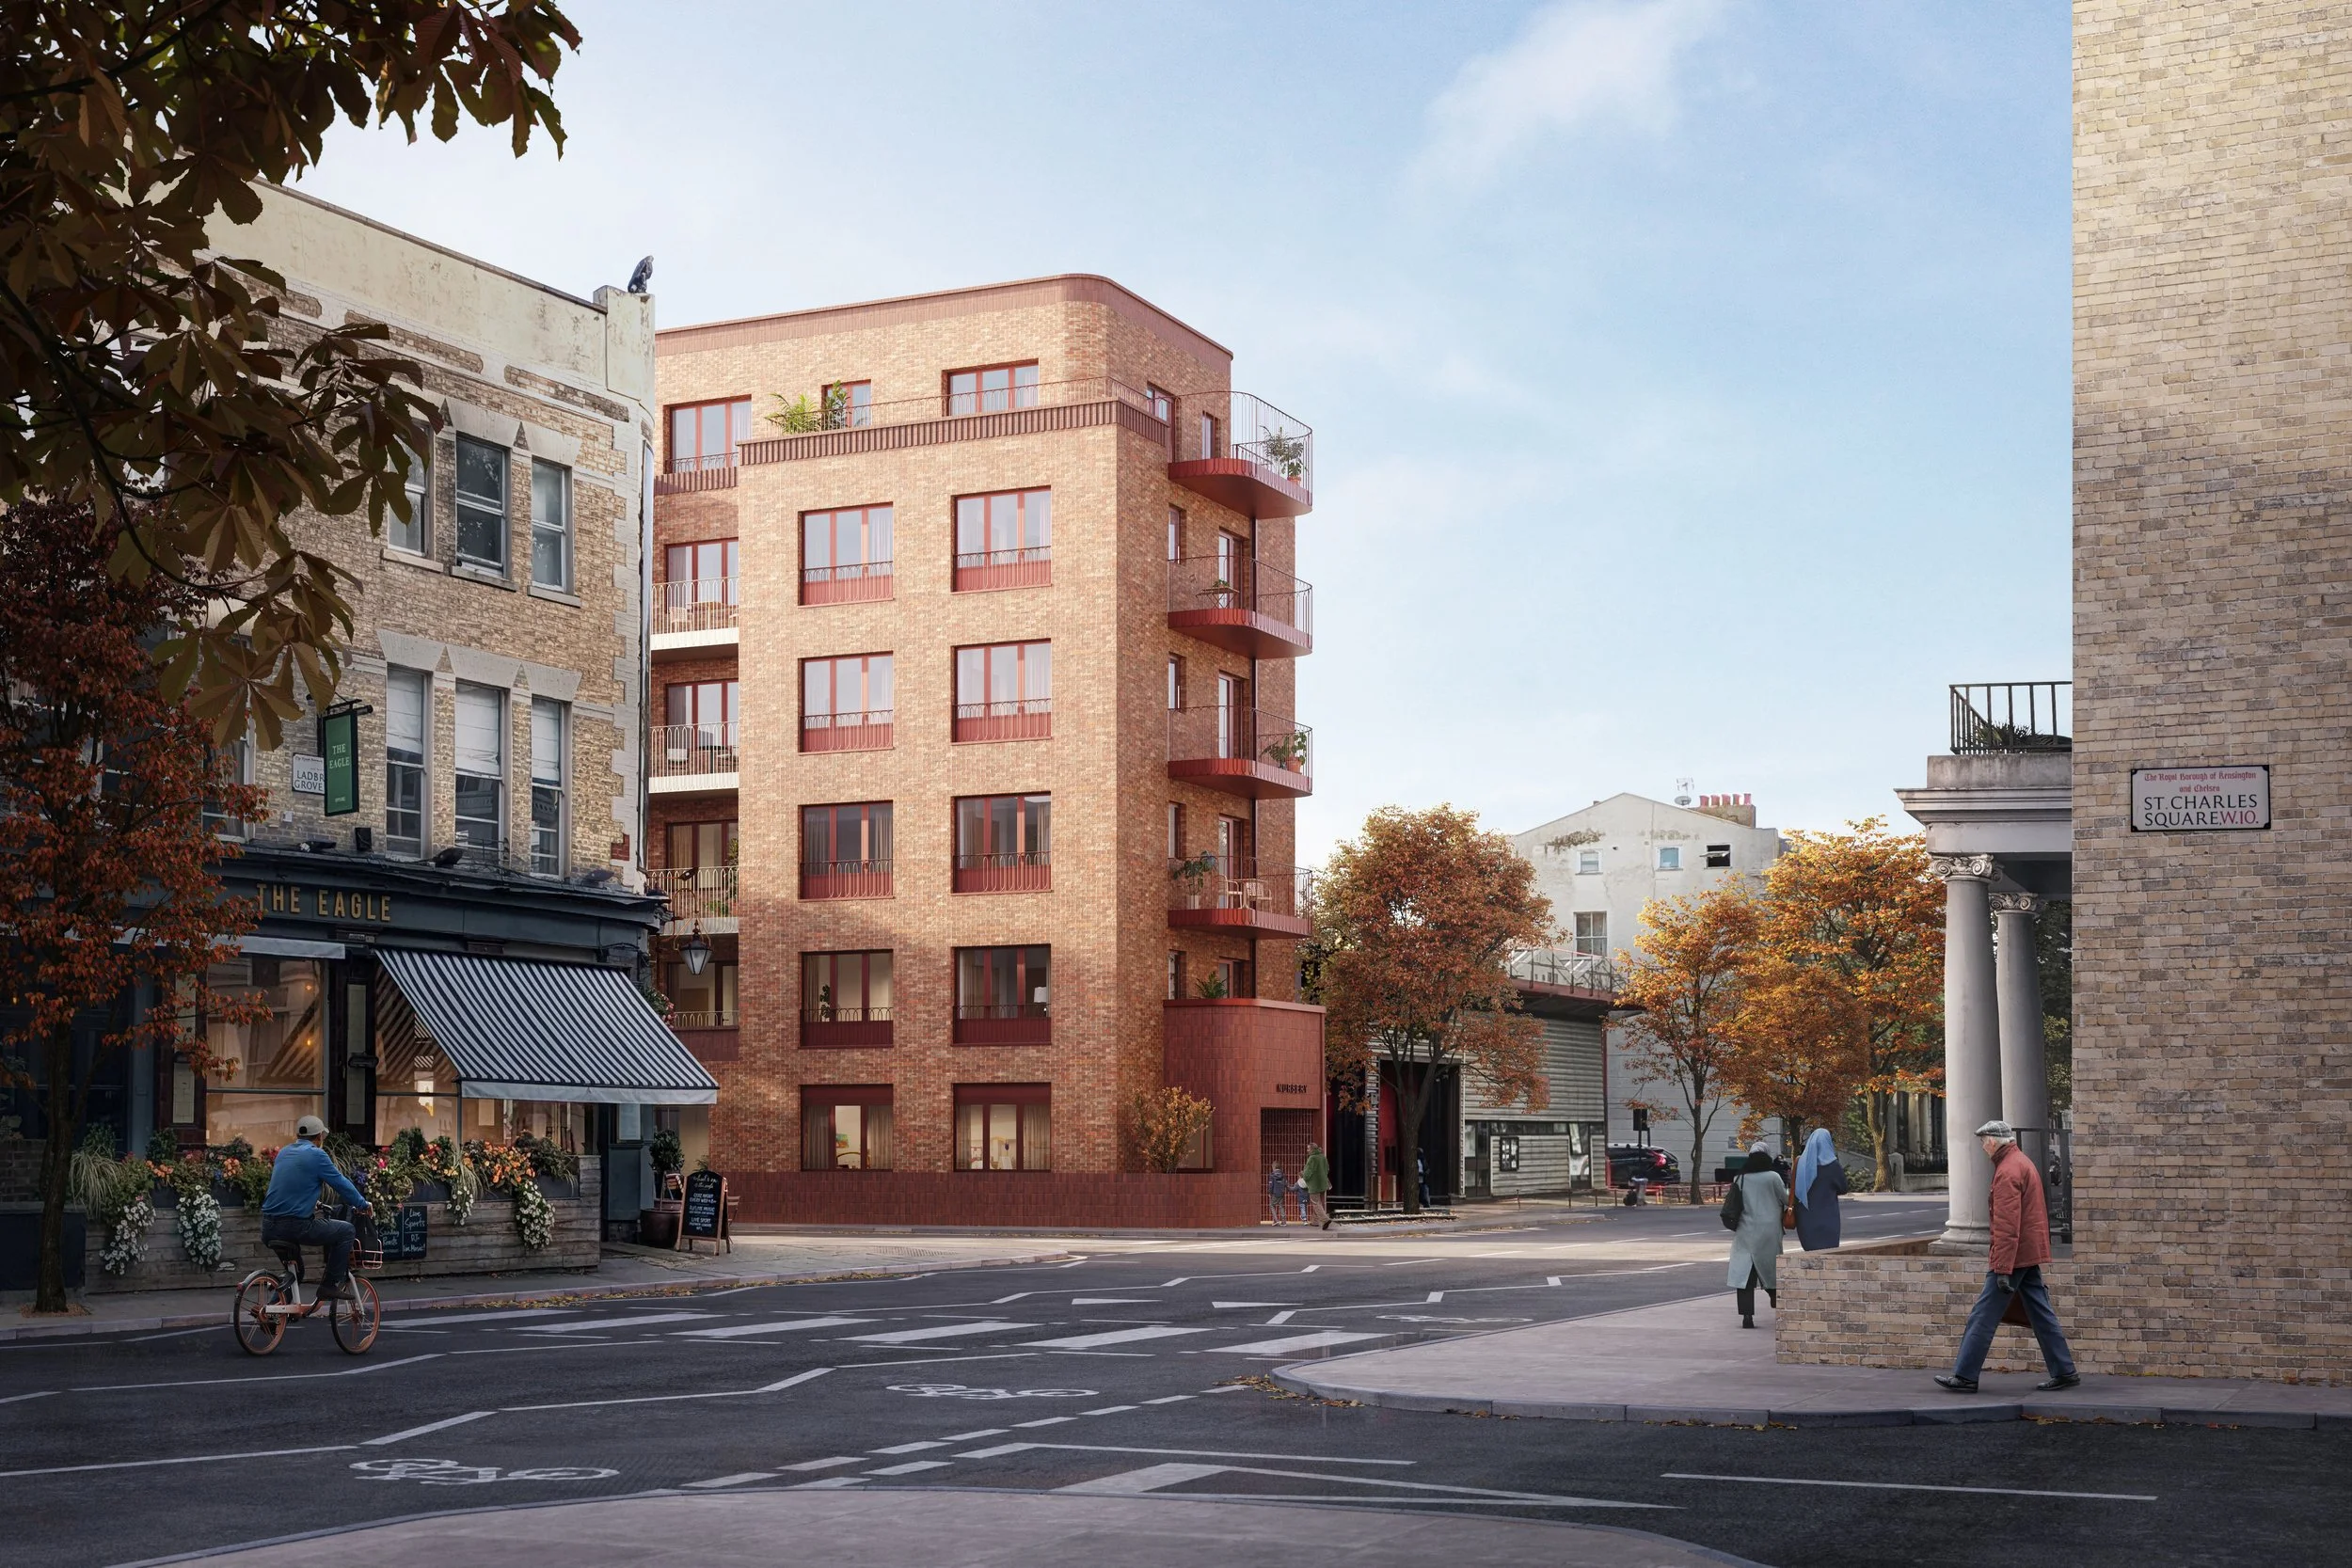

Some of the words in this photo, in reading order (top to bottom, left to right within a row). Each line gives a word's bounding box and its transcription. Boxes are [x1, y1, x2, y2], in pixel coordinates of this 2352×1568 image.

[332, 743, 346, 754] THE
[329, 756, 350, 769] EAGLE
[296, 770, 325, 782] LADBR
[2145, 773, 2157, 782] The
[2158, 773, 2177, 782] Royal
[2180, 772, 2208, 782] Borough
[2219, 771, 2257, 781] Kensington
[294, 780, 324, 791] GROVE
[2194, 784, 2220, 793] Chelsea
[257, 883, 301, 913] THE
[318, 889, 391, 921] EAGLE
[1276, 1083, 1307, 1093] NURSERY
[409, 1208, 421, 1217] Live
[405, 1217, 425, 1230] Sports
